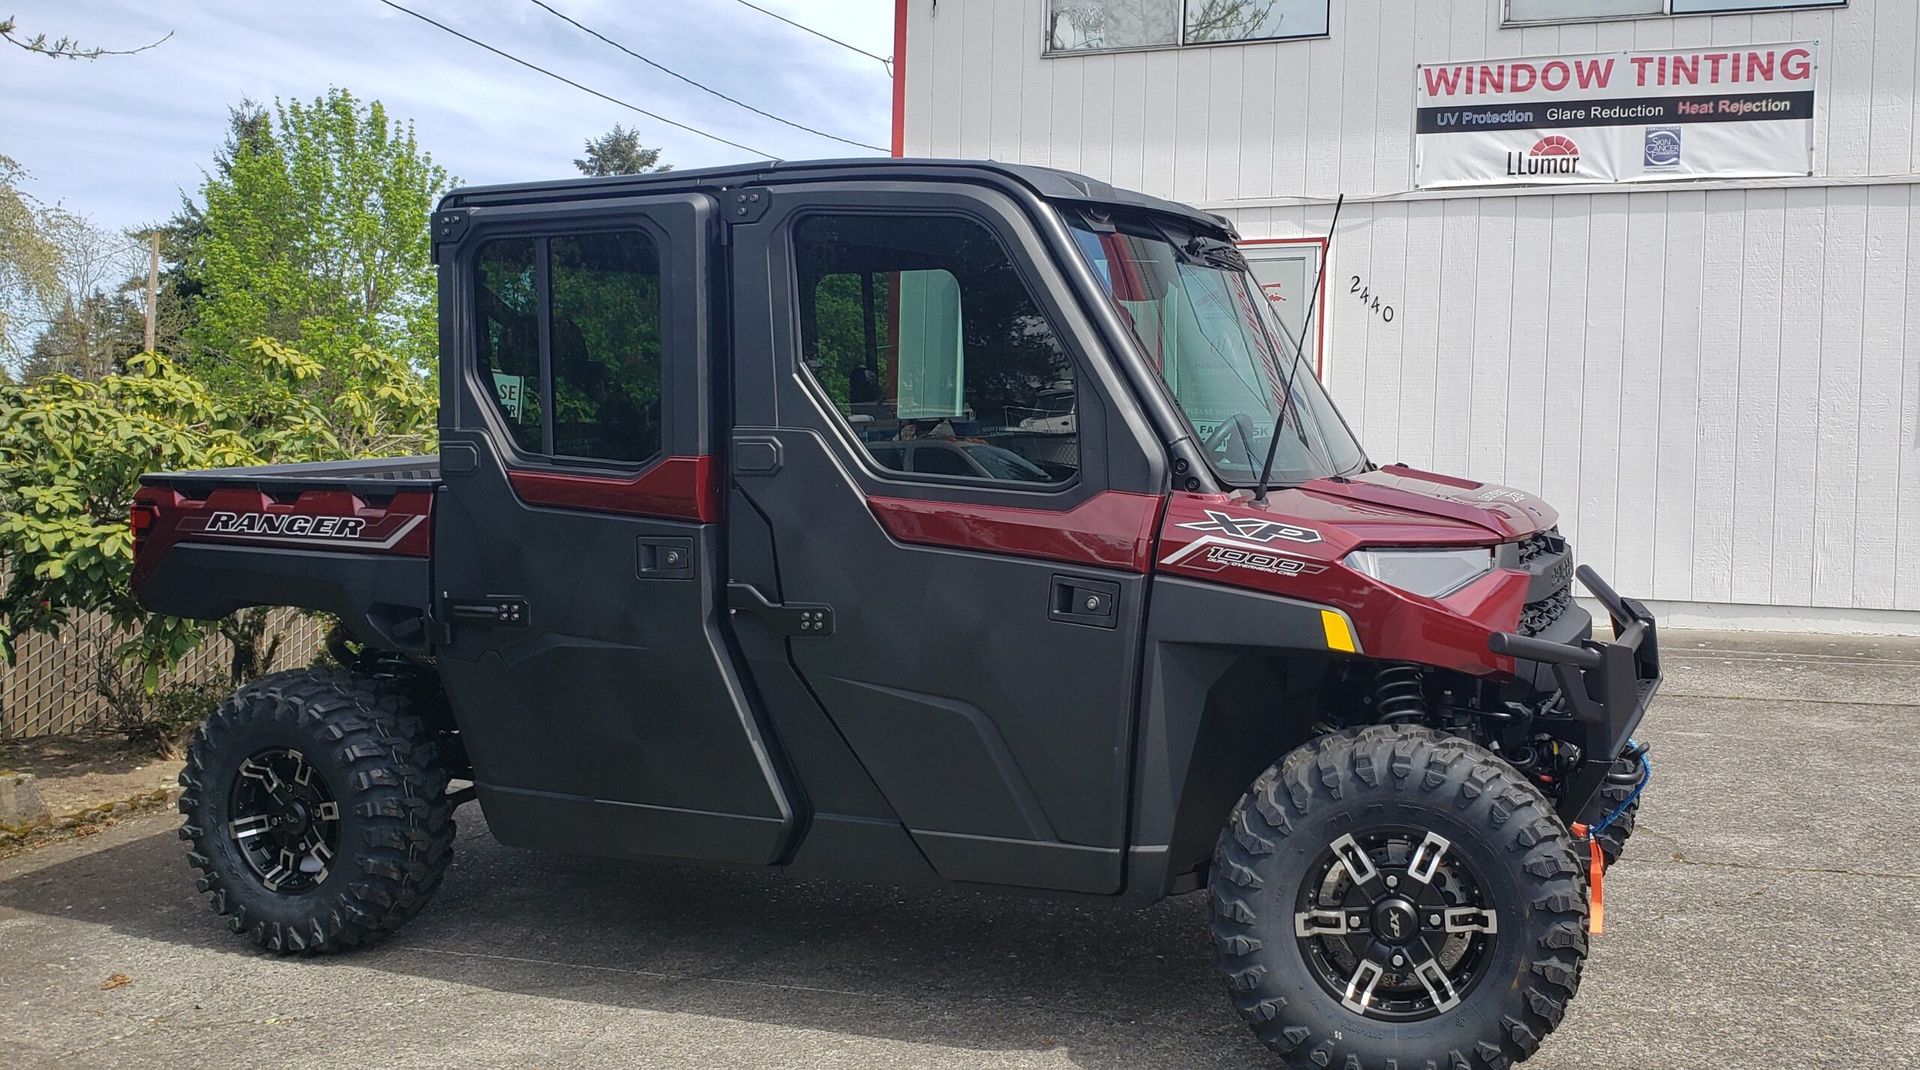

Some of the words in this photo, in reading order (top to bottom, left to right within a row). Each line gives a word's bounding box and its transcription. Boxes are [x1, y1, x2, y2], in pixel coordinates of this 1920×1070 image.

[1423, 58, 1615, 97] WINDOW
[1630, 48, 1811, 87] TINTING
[1436, 112, 1459, 126] UV
[1462, 110, 1534, 125] Protection
[1546, 108, 1586, 121] Glare
[1590, 104, 1664, 119] Reduction
[1677, 100, 1714, 115] Heat
[1717, 98, 1791, 116] Rejection
[1645, 143, 1680, 153] CANCER
[1652, 137, 1672, 146] SKIN
[1506, 151, 1580, 176] LLumar
[1350, 275, 1394, 323] 2440
[205, 511, 366, 538] RANGER
[1174, 509, 1323, 543] XP
[1207, 546, 1305, 573] 1000
[1207, 557, 1230, 565] DUAL
[1231, 561, 1277, 574] OVERHEAD
